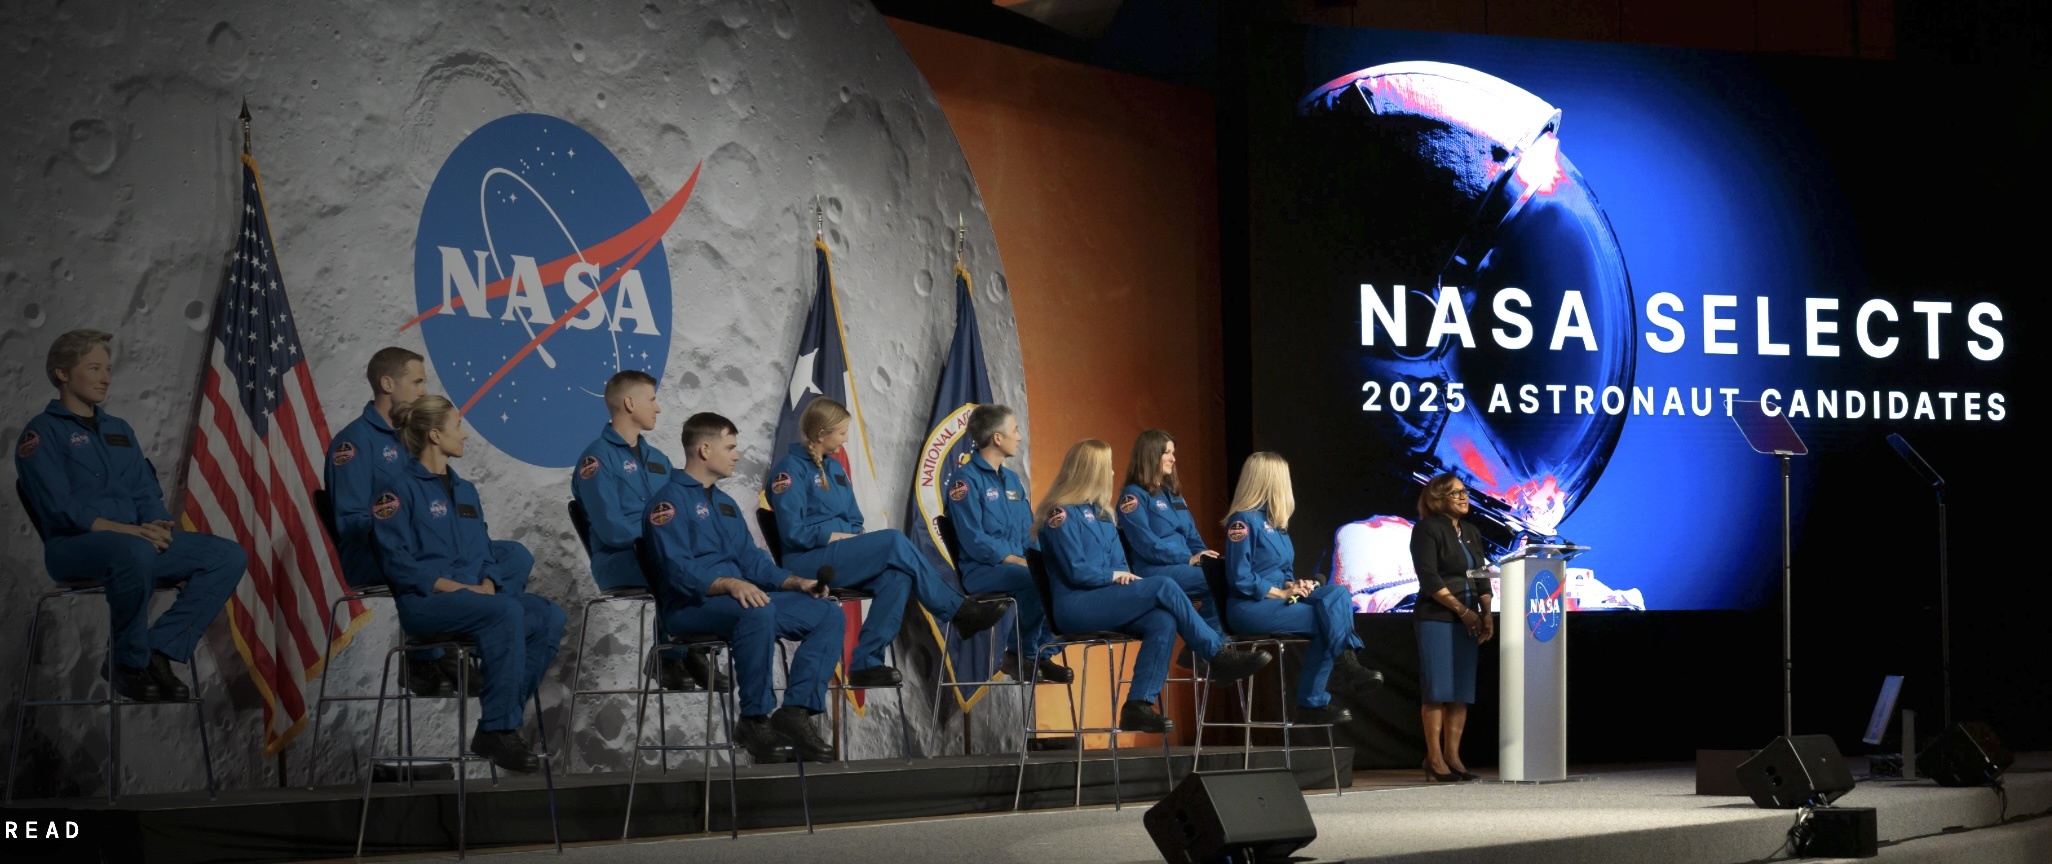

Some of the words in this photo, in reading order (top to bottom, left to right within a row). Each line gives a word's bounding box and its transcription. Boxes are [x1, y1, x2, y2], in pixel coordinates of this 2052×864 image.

[438, 246, 661, 336] NASA
[1360, 283, 1599, 351] NASA
[1645, 291, 2005, 361] SELECTS
[1362, 381, 1465, 413] 2025
[1488, 383, 1740, 417] ASTRONAUT
[1760, 388, 2006, 421] CANDIDATES
[921, 428, 956, 487] NATIONAL
[1530, 598, 1560, 614] NASA
